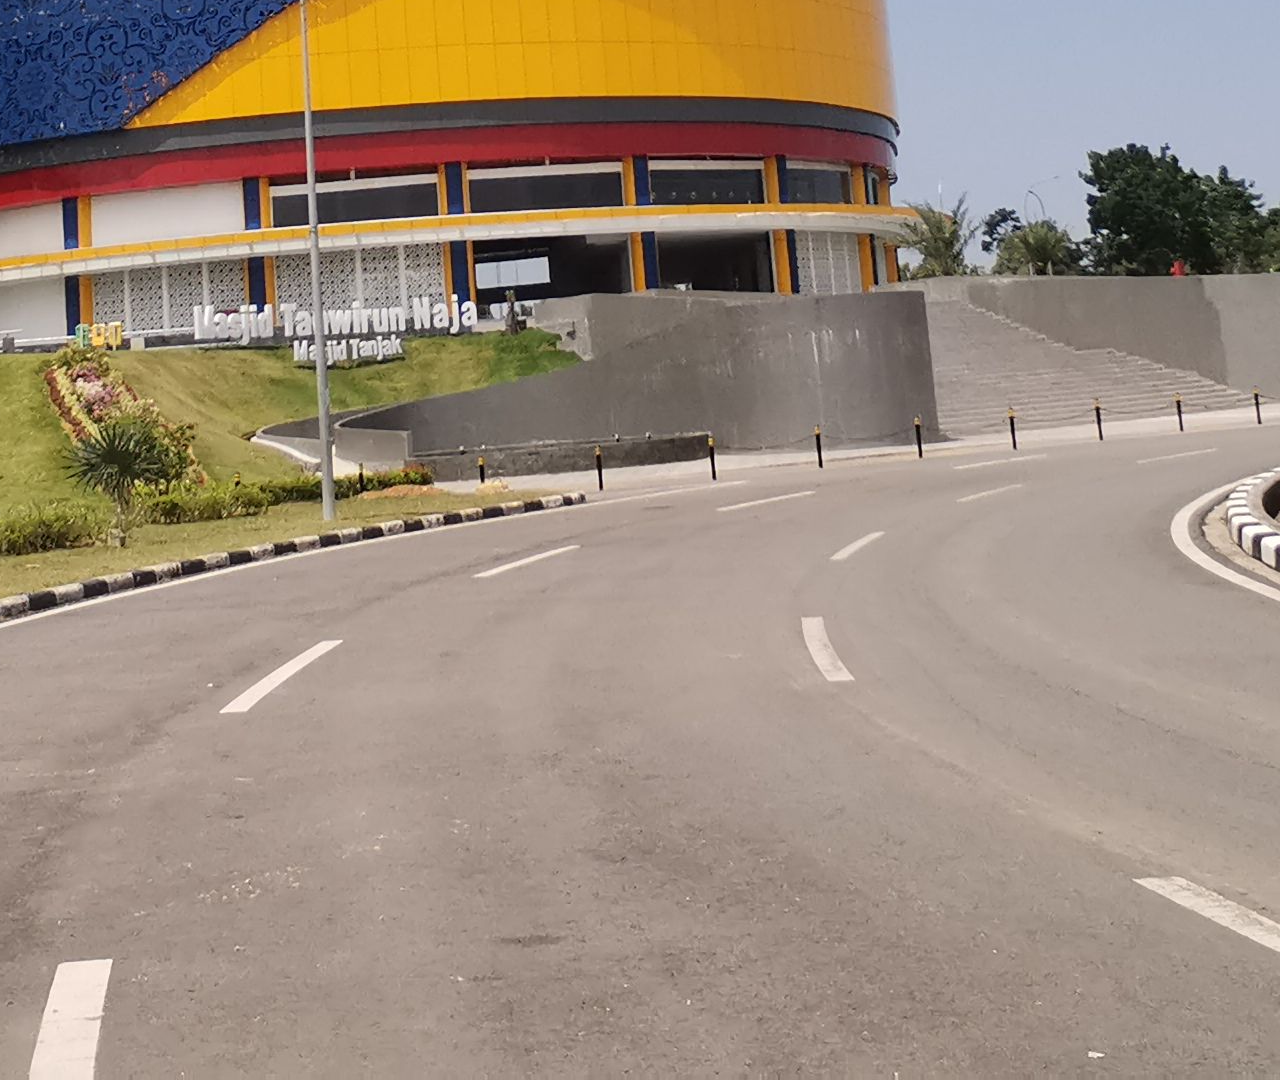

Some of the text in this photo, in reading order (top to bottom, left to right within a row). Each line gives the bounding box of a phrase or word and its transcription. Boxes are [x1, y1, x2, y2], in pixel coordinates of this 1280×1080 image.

[193, 303, 274, 345] Masjid
[412, 293, 478, 334] Naja
[293, 334, 403, 366] Majid Tanjak
